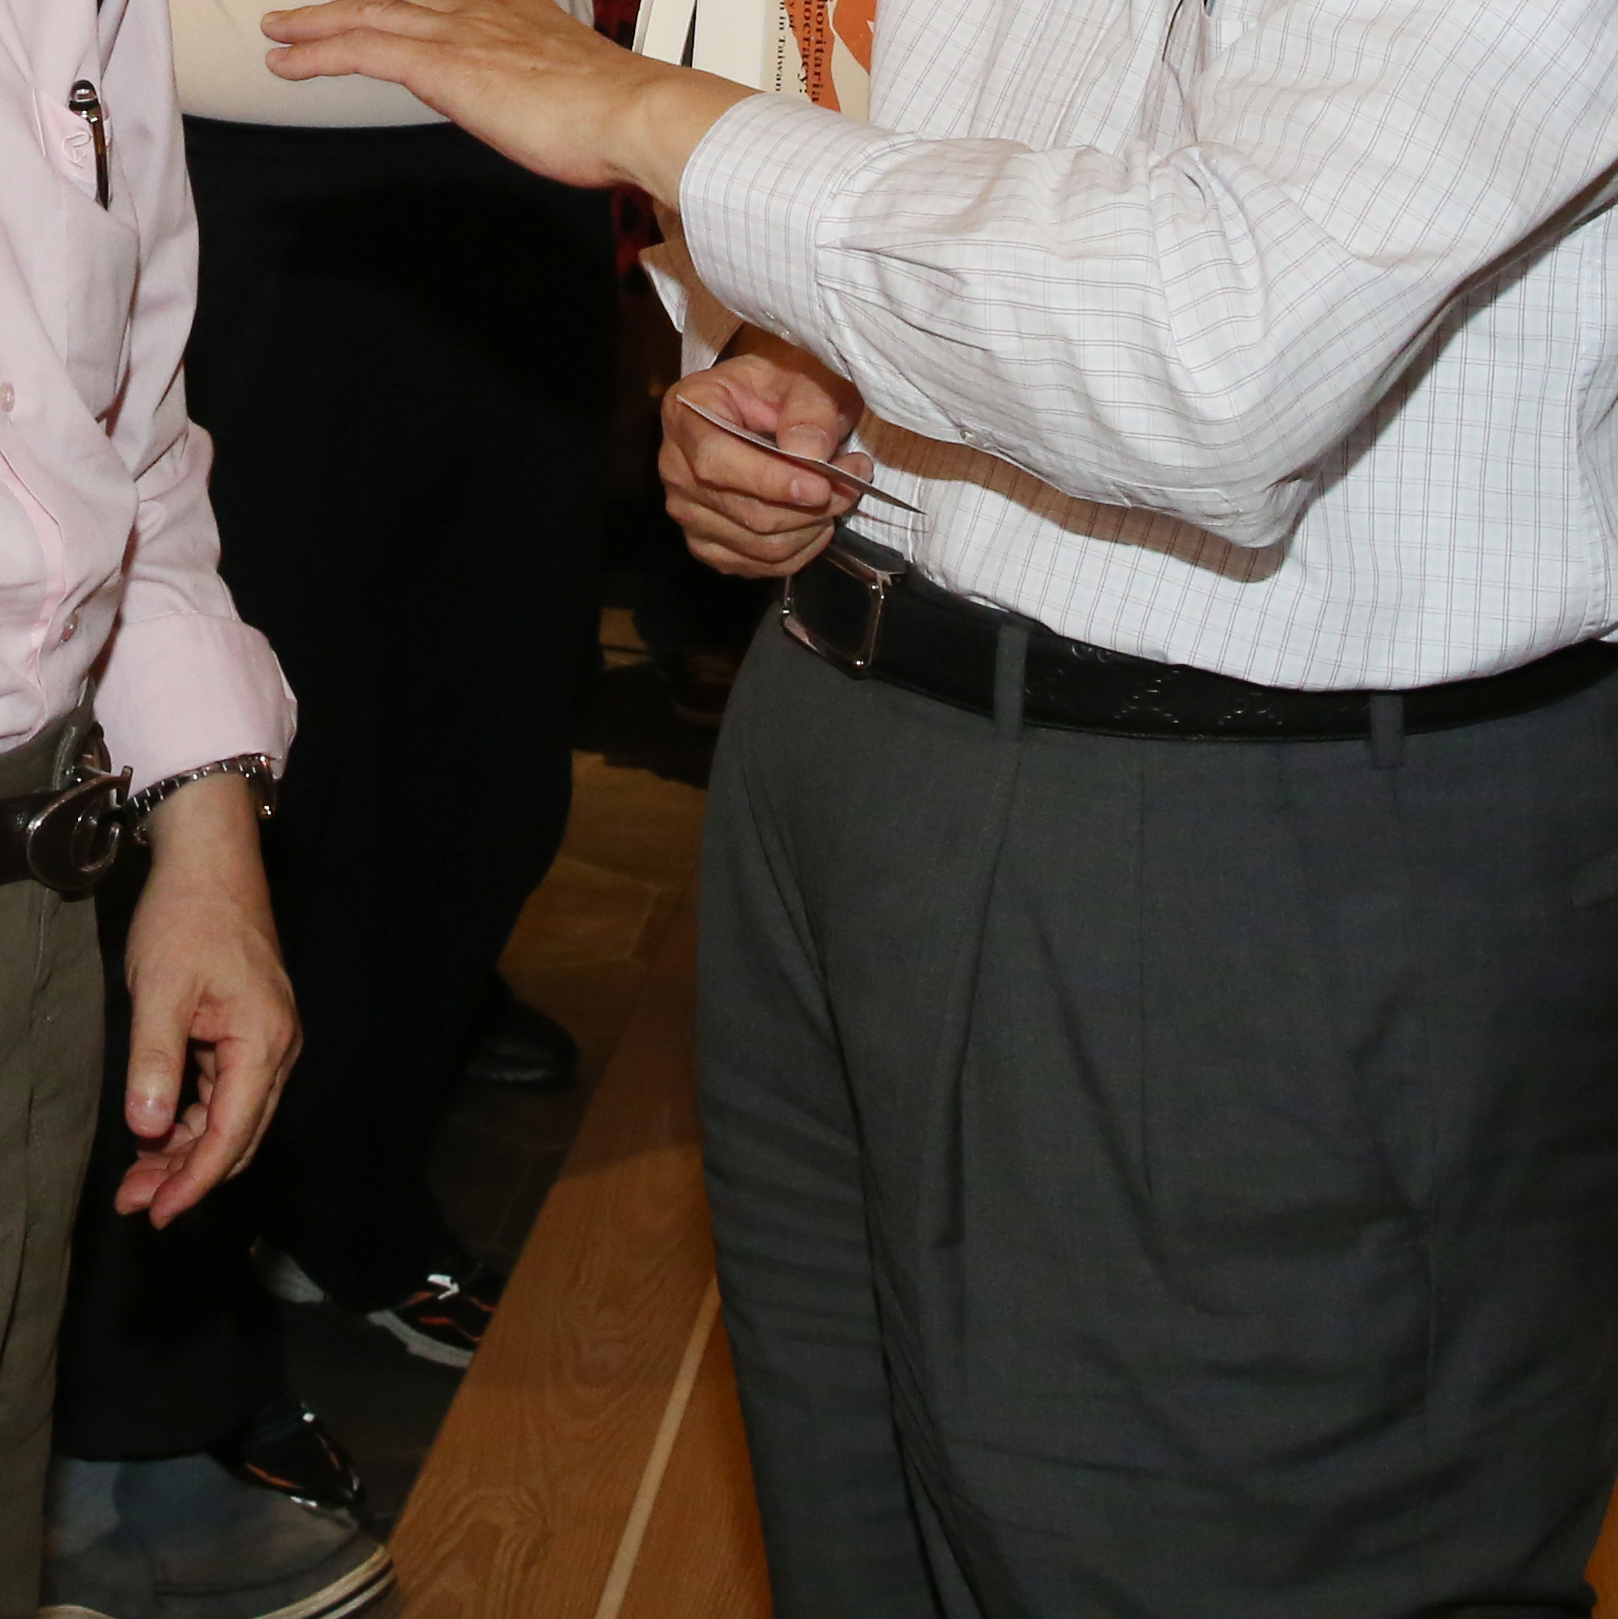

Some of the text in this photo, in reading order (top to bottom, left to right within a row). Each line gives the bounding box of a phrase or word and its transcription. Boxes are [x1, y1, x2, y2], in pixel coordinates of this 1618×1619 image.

[779, 16, 787, 31] in
[789, 14, 796, 31] of
[776, 36, 785, 92] Taiwan
